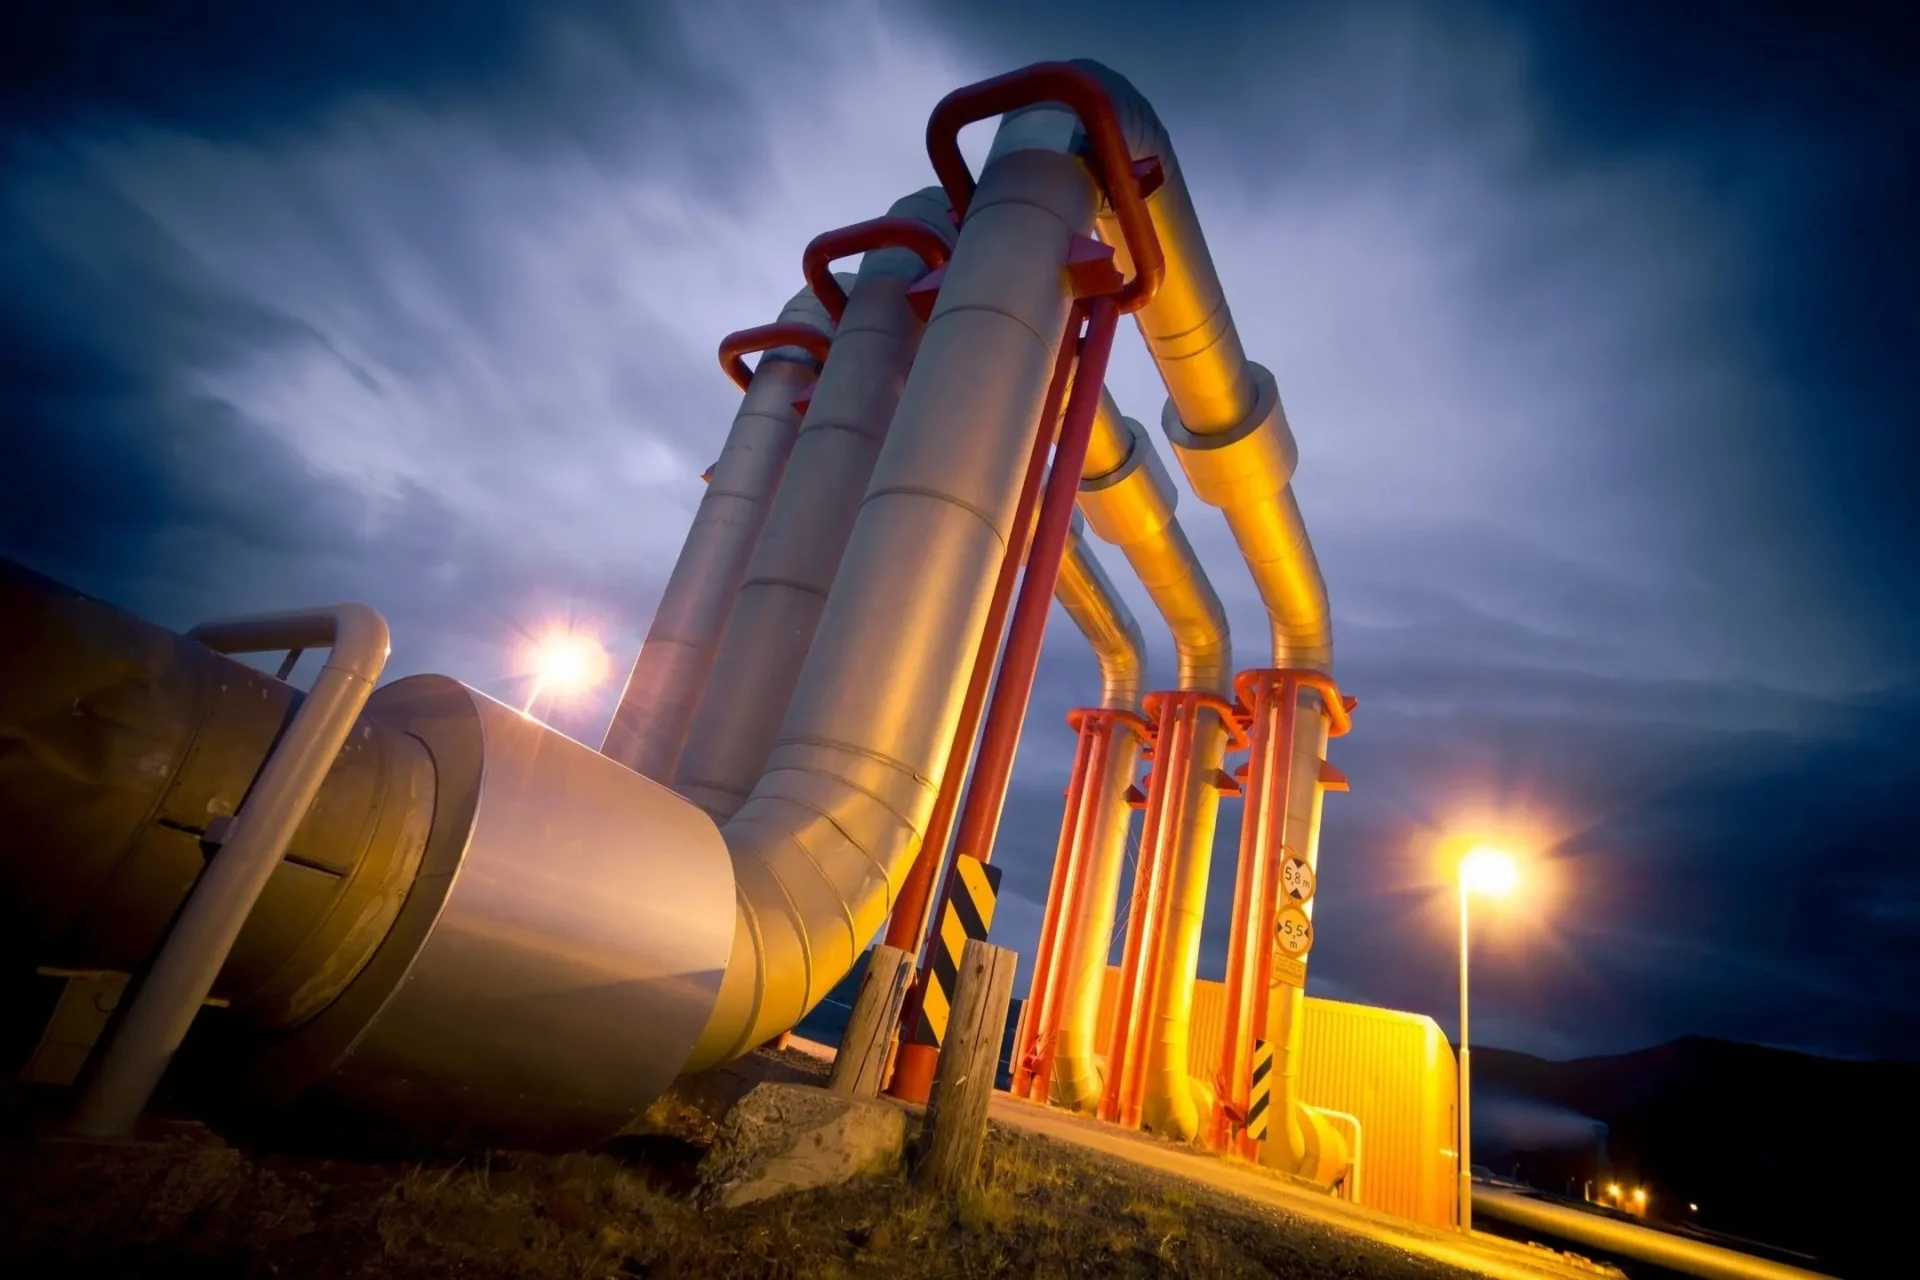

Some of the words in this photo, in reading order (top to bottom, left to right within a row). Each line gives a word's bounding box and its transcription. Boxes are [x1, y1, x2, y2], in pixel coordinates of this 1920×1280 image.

[1285, 866, 1301, 885] 5,8
[1302, 880, 1310, 888] m
[1284, 920, 1303, 939] 5,5
[1289, 941, 1298, 949] m
